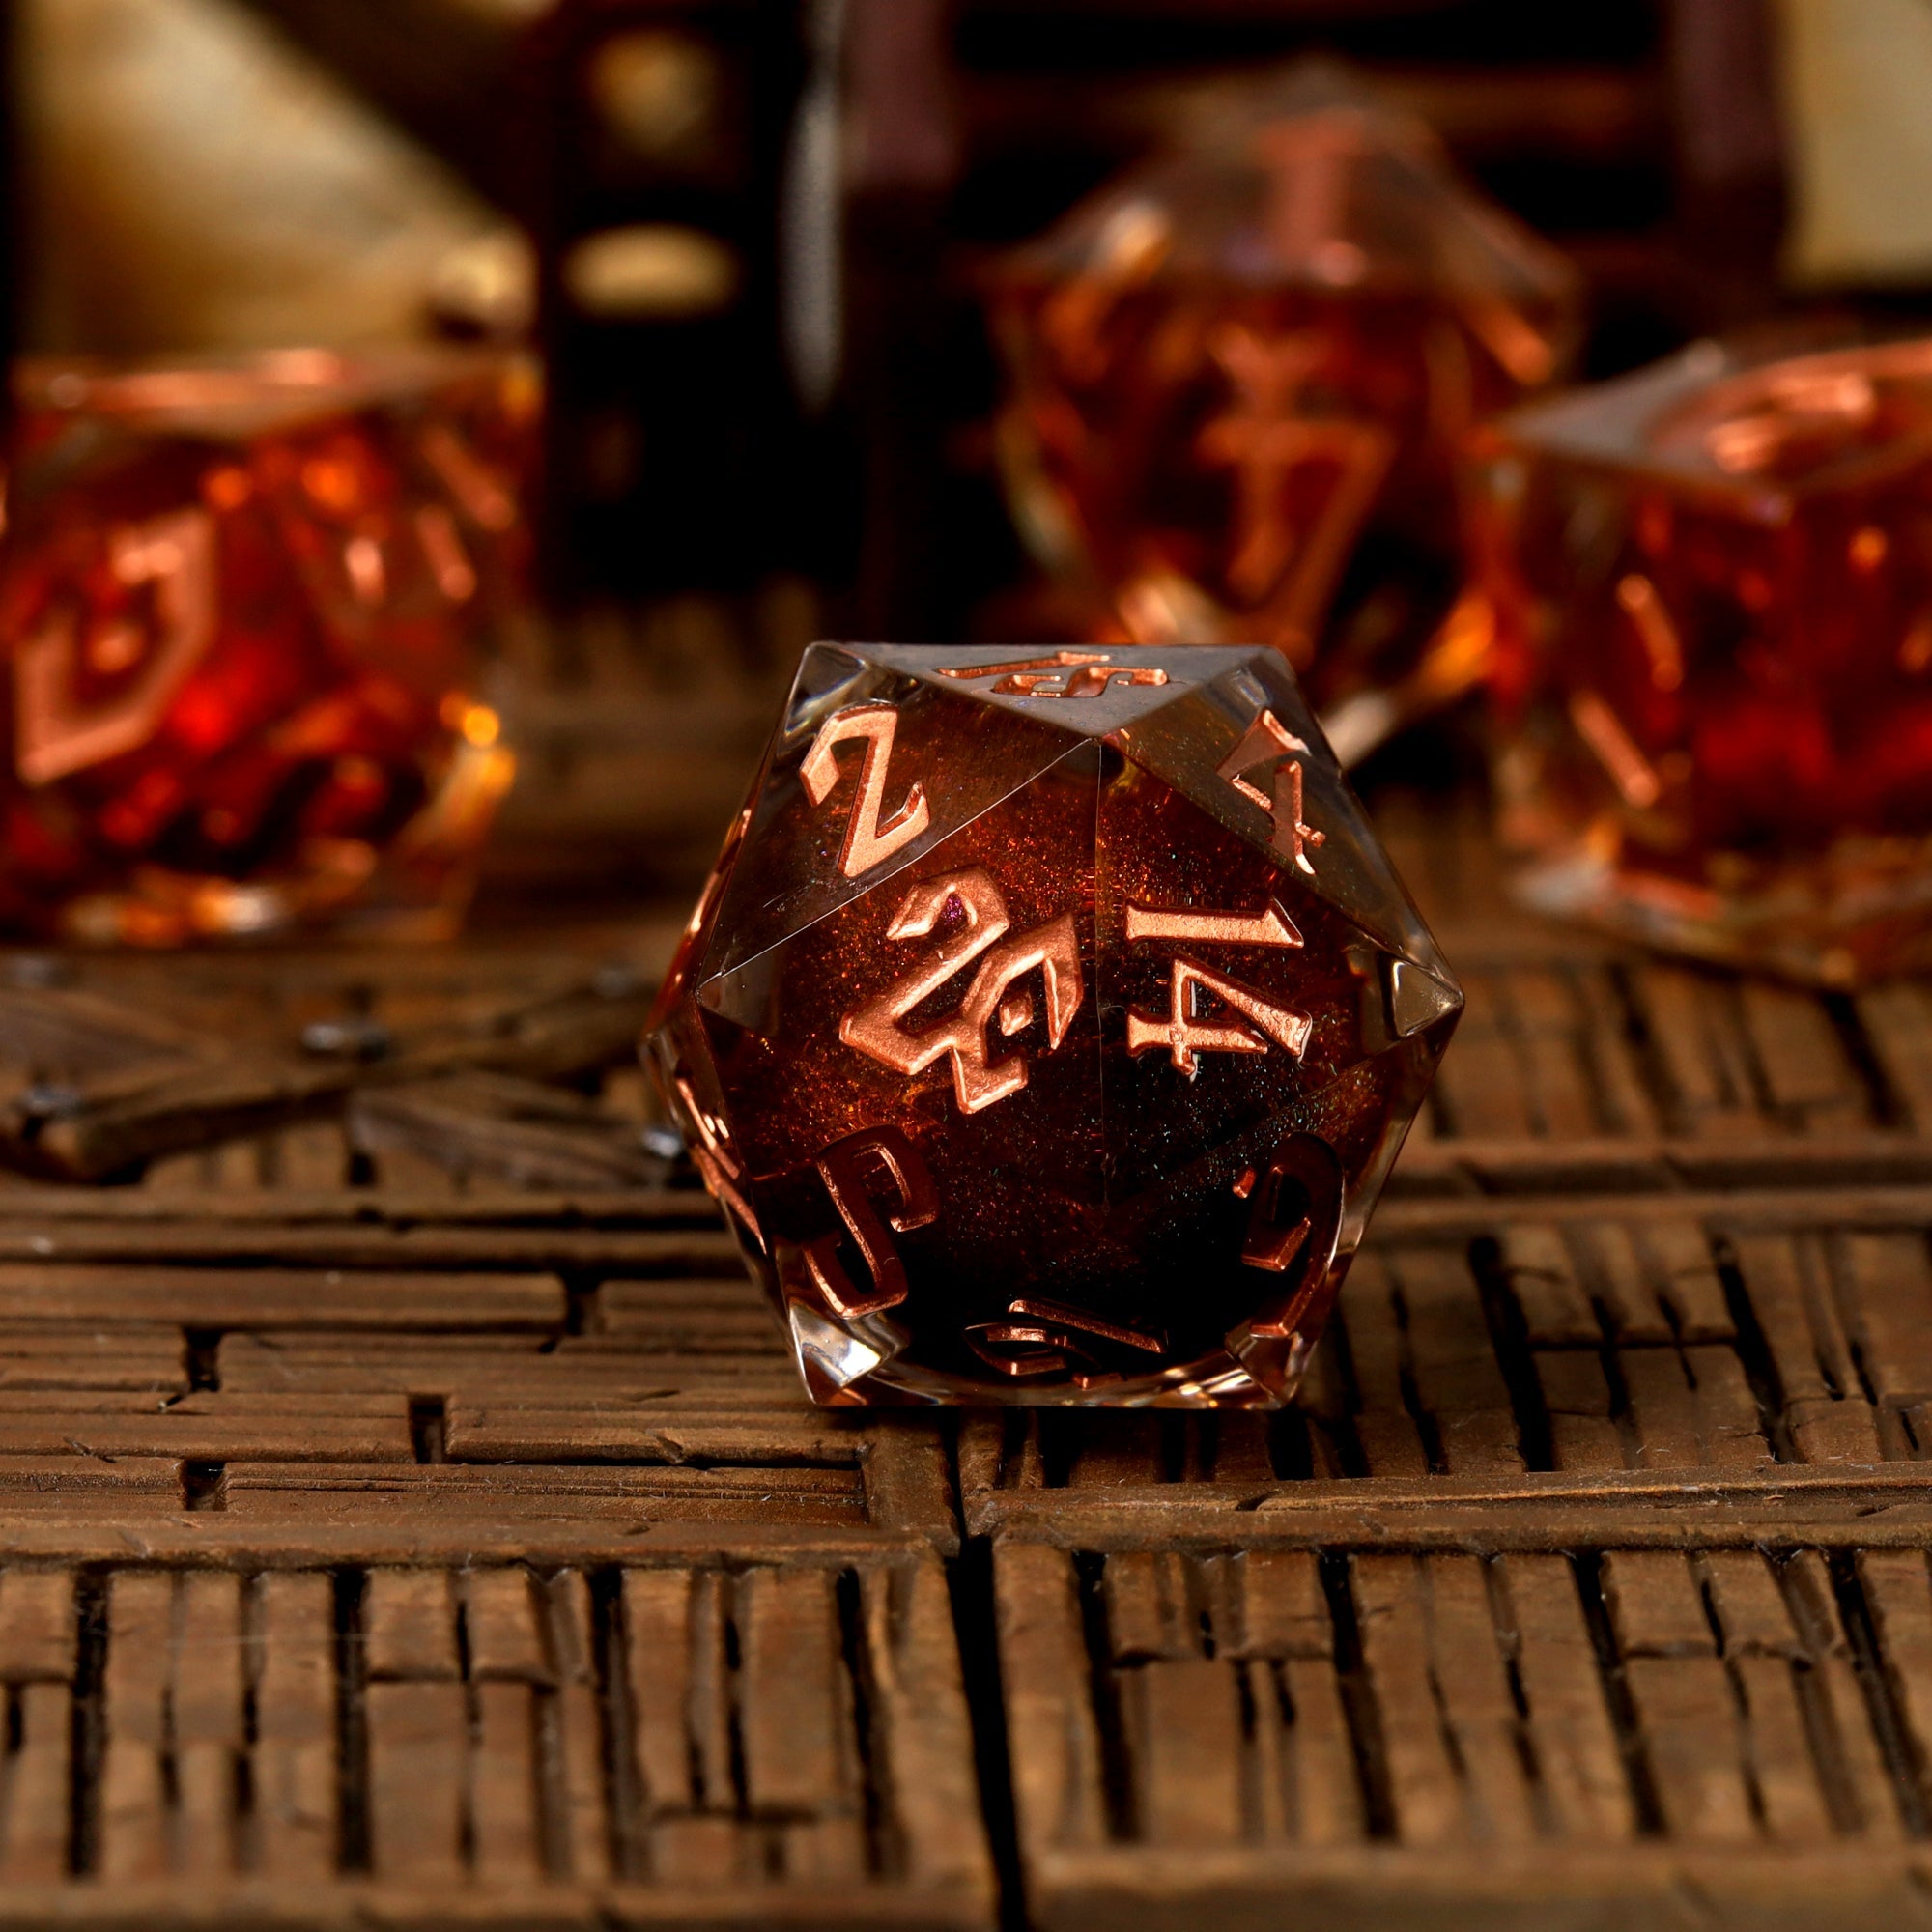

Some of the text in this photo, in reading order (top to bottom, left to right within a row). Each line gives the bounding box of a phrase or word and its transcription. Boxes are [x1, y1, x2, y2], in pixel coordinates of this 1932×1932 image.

[800, 702, 930, 878] 2
[1215, 708, 1326, 875] 4
[1126, 898, 1314, 1080] 14
